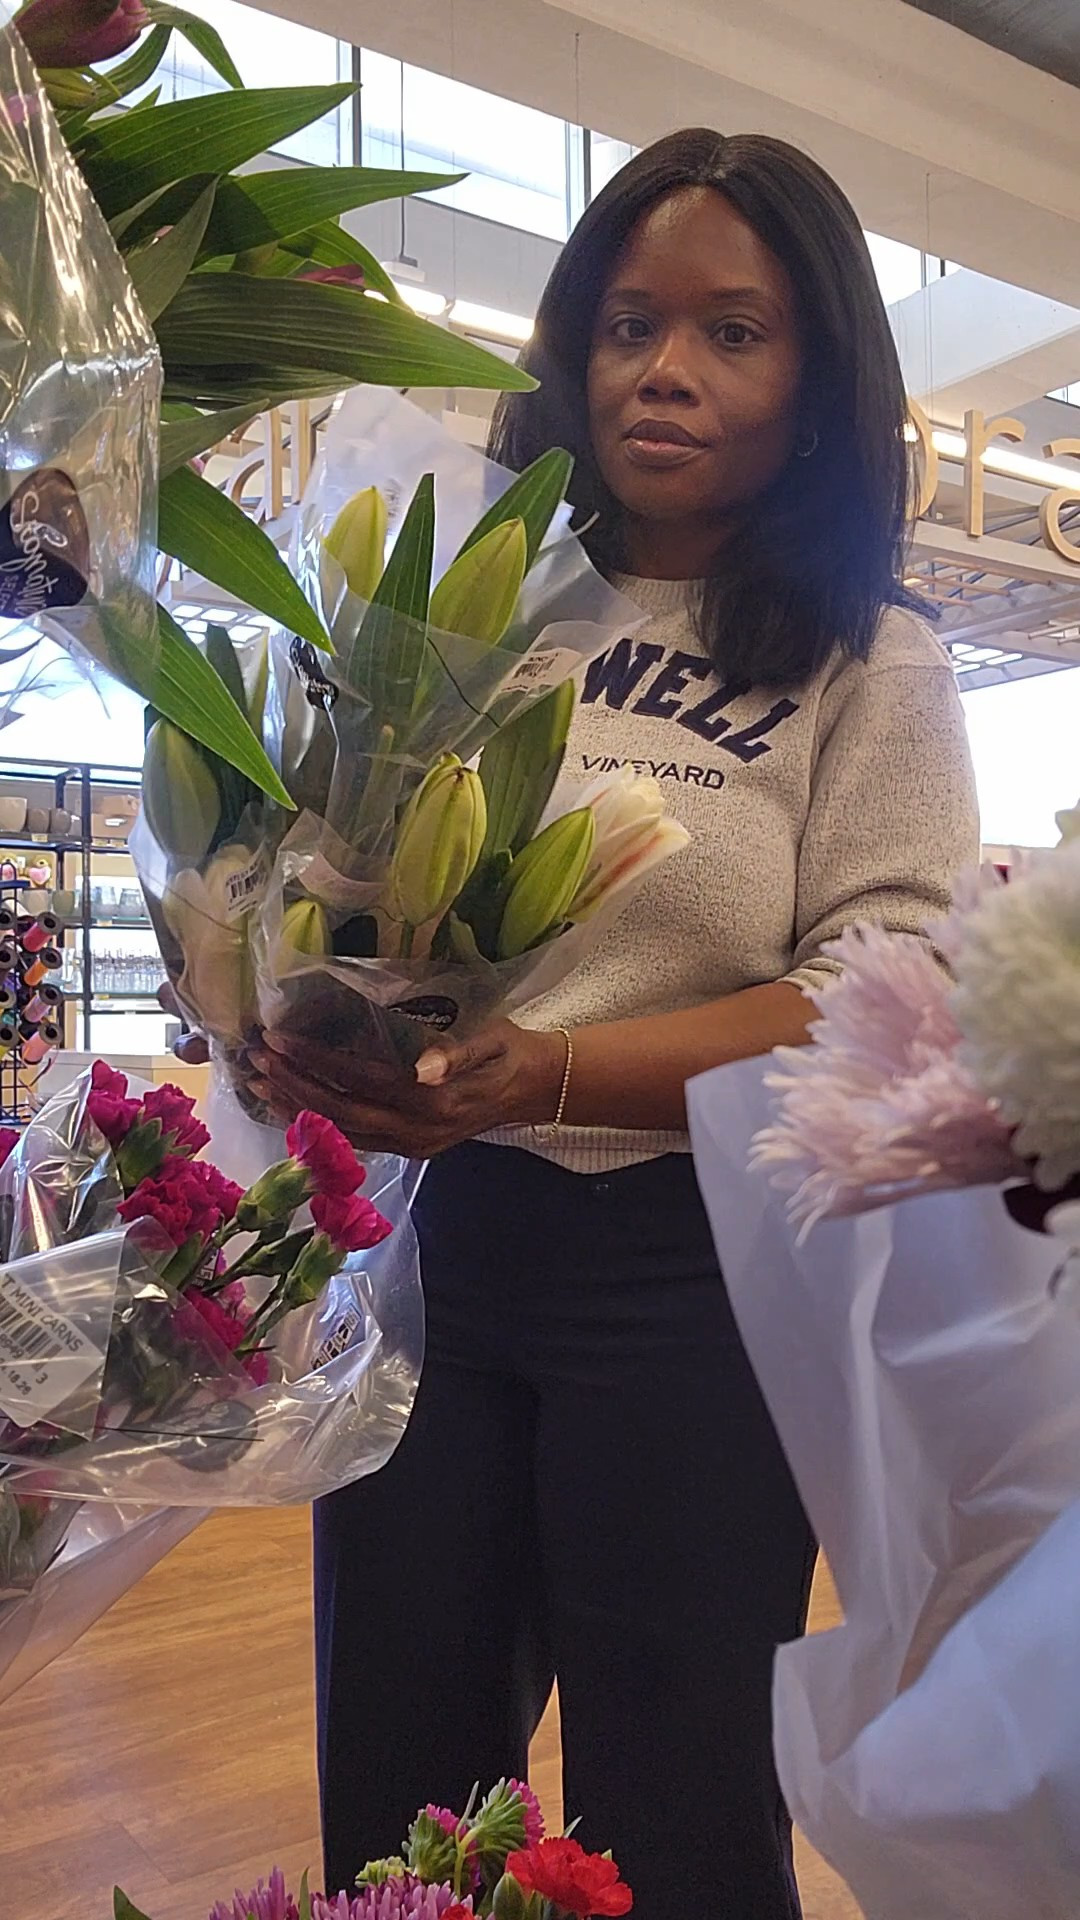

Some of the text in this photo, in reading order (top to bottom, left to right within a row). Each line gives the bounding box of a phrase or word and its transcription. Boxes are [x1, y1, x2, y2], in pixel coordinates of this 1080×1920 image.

[582, 755, 725, 790] VINEYARD
[9, 1286, 43, 1317] MINI
[40, 1315, 84, 1352] CARNS
